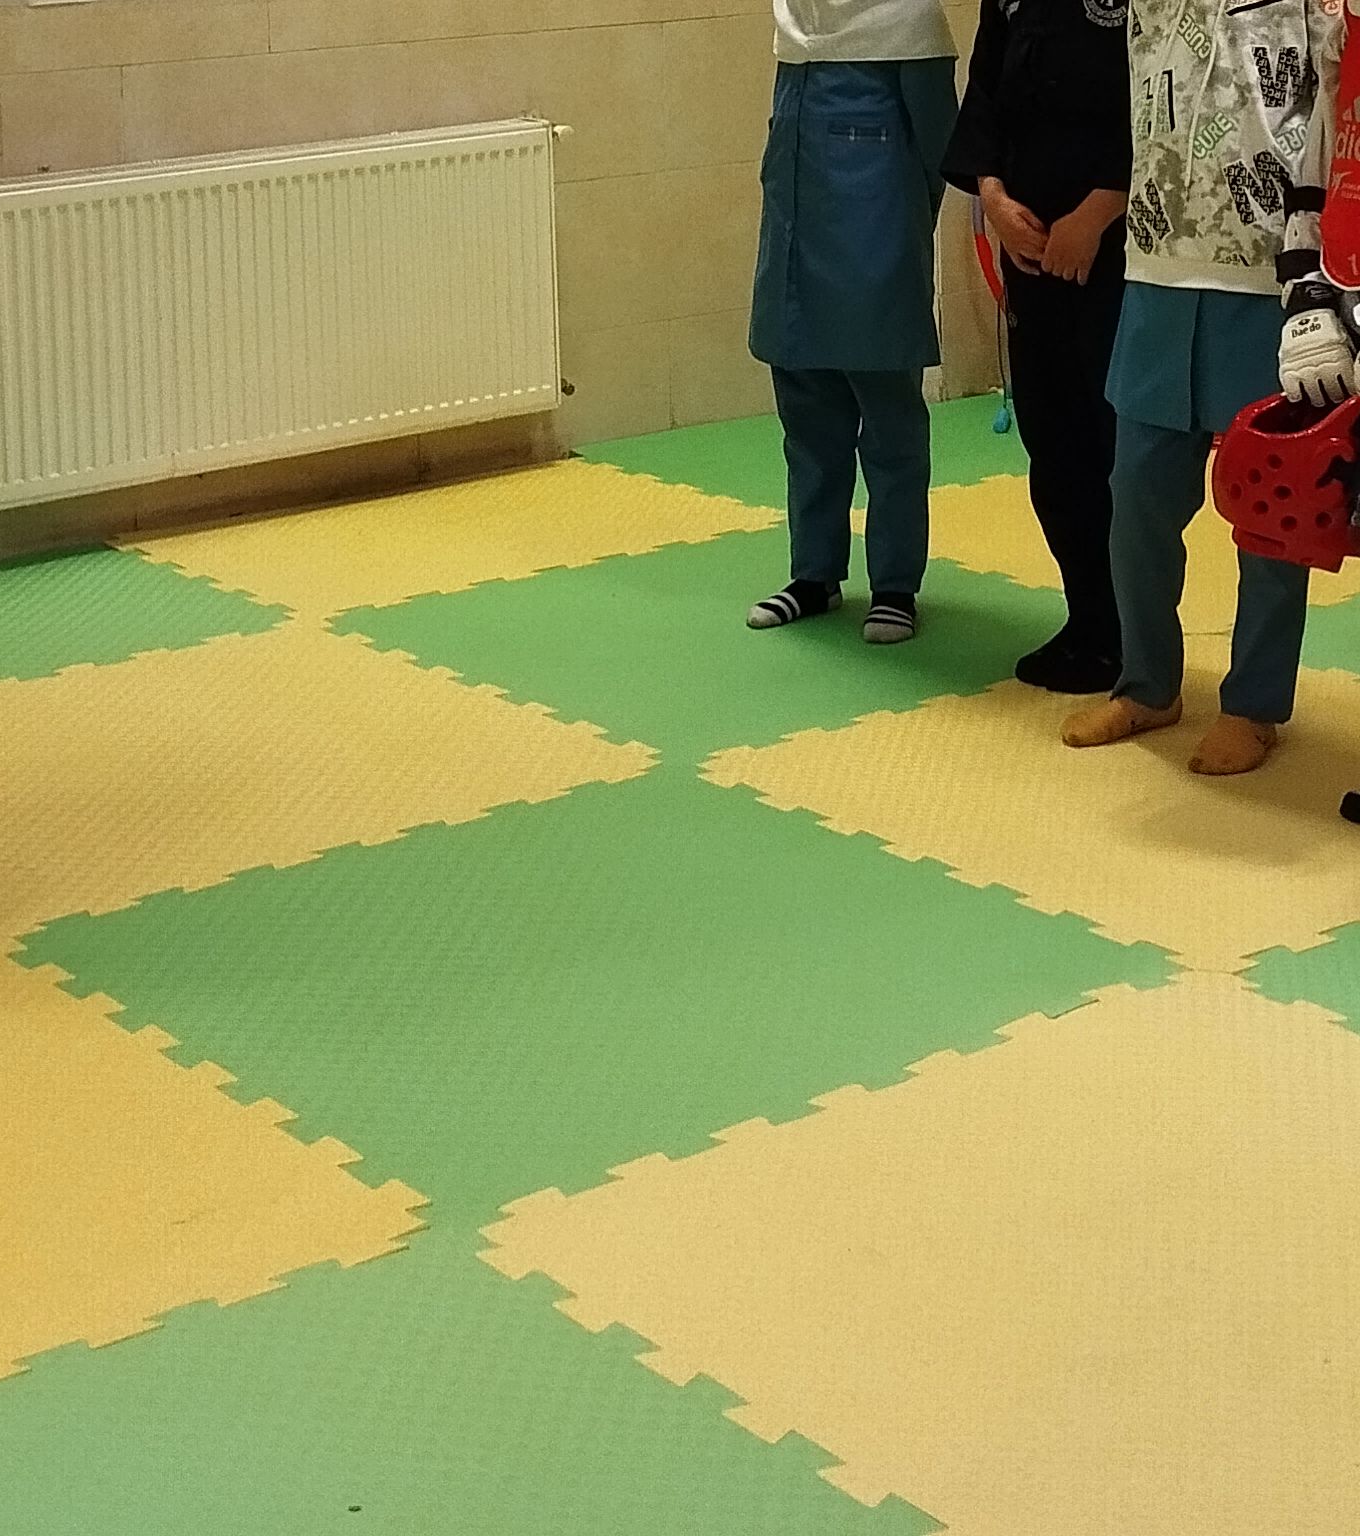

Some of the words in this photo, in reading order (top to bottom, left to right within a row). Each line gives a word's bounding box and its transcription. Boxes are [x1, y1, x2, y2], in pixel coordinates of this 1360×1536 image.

[1177, 13, 1213, 60] CURE
[1192, 112, 1235, 160] CURE
[1348, 253, 1359, 277] 1
